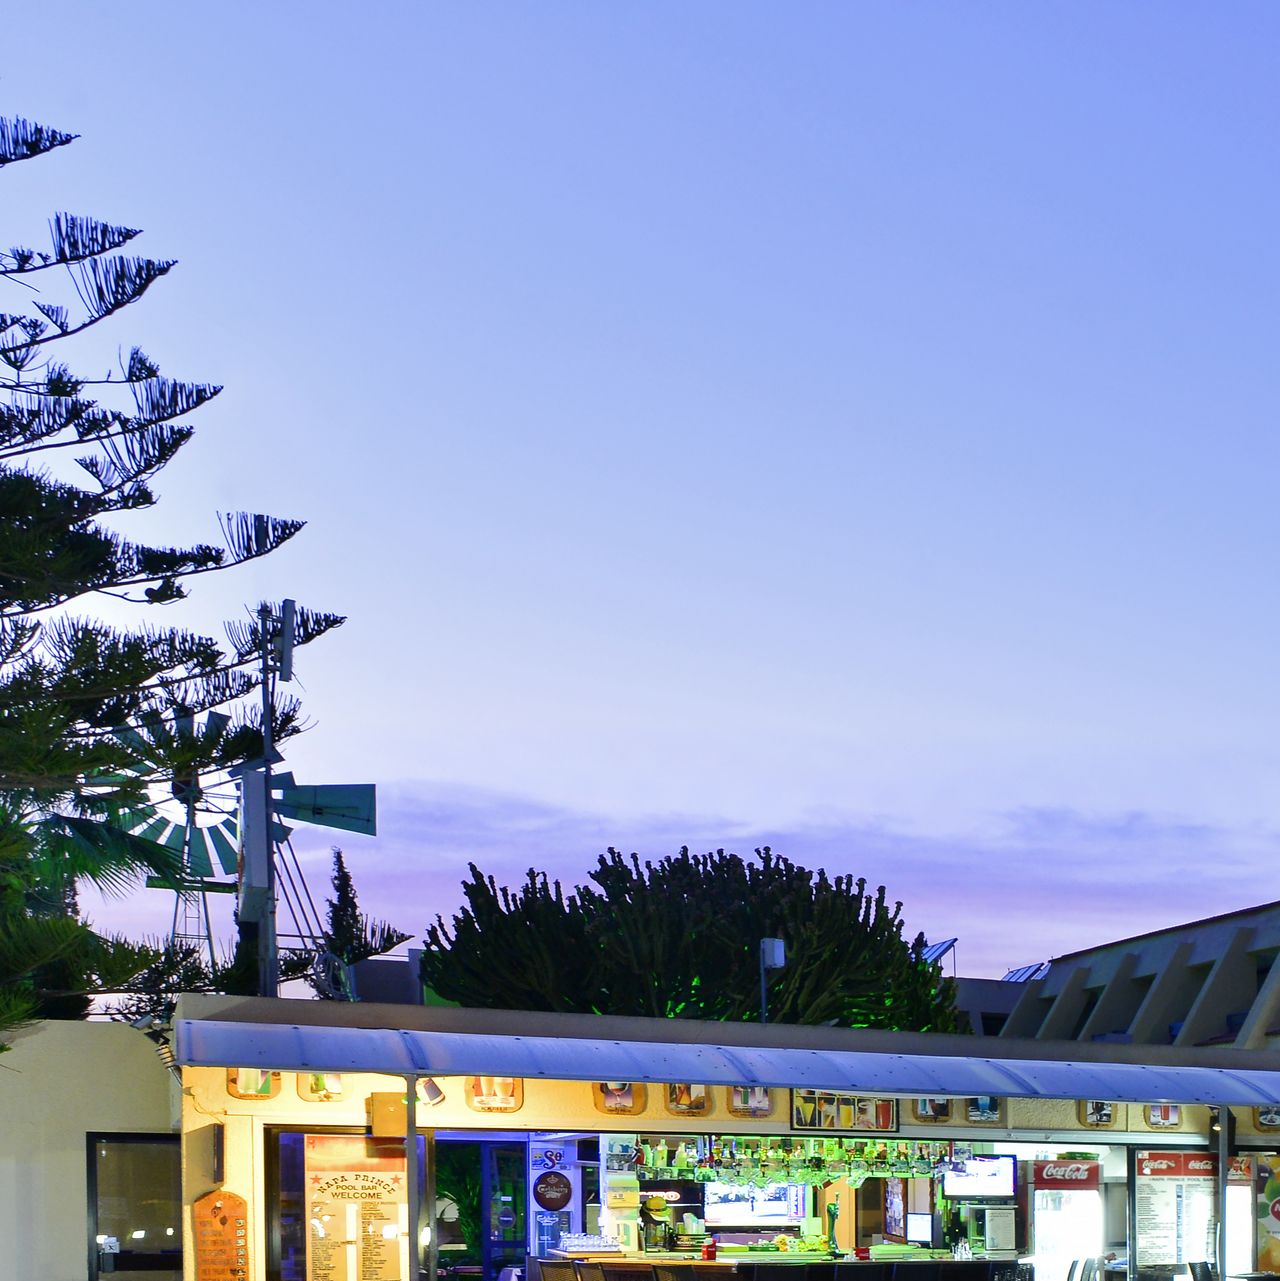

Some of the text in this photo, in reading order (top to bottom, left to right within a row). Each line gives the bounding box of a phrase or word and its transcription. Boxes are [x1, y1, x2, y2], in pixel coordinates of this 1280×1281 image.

[1043, 1163, 1090, 1179] Coca-Cola
[354, 1173, 396, 1195] PRINCE
[331, 1191, 383, 1199] WELCOME
